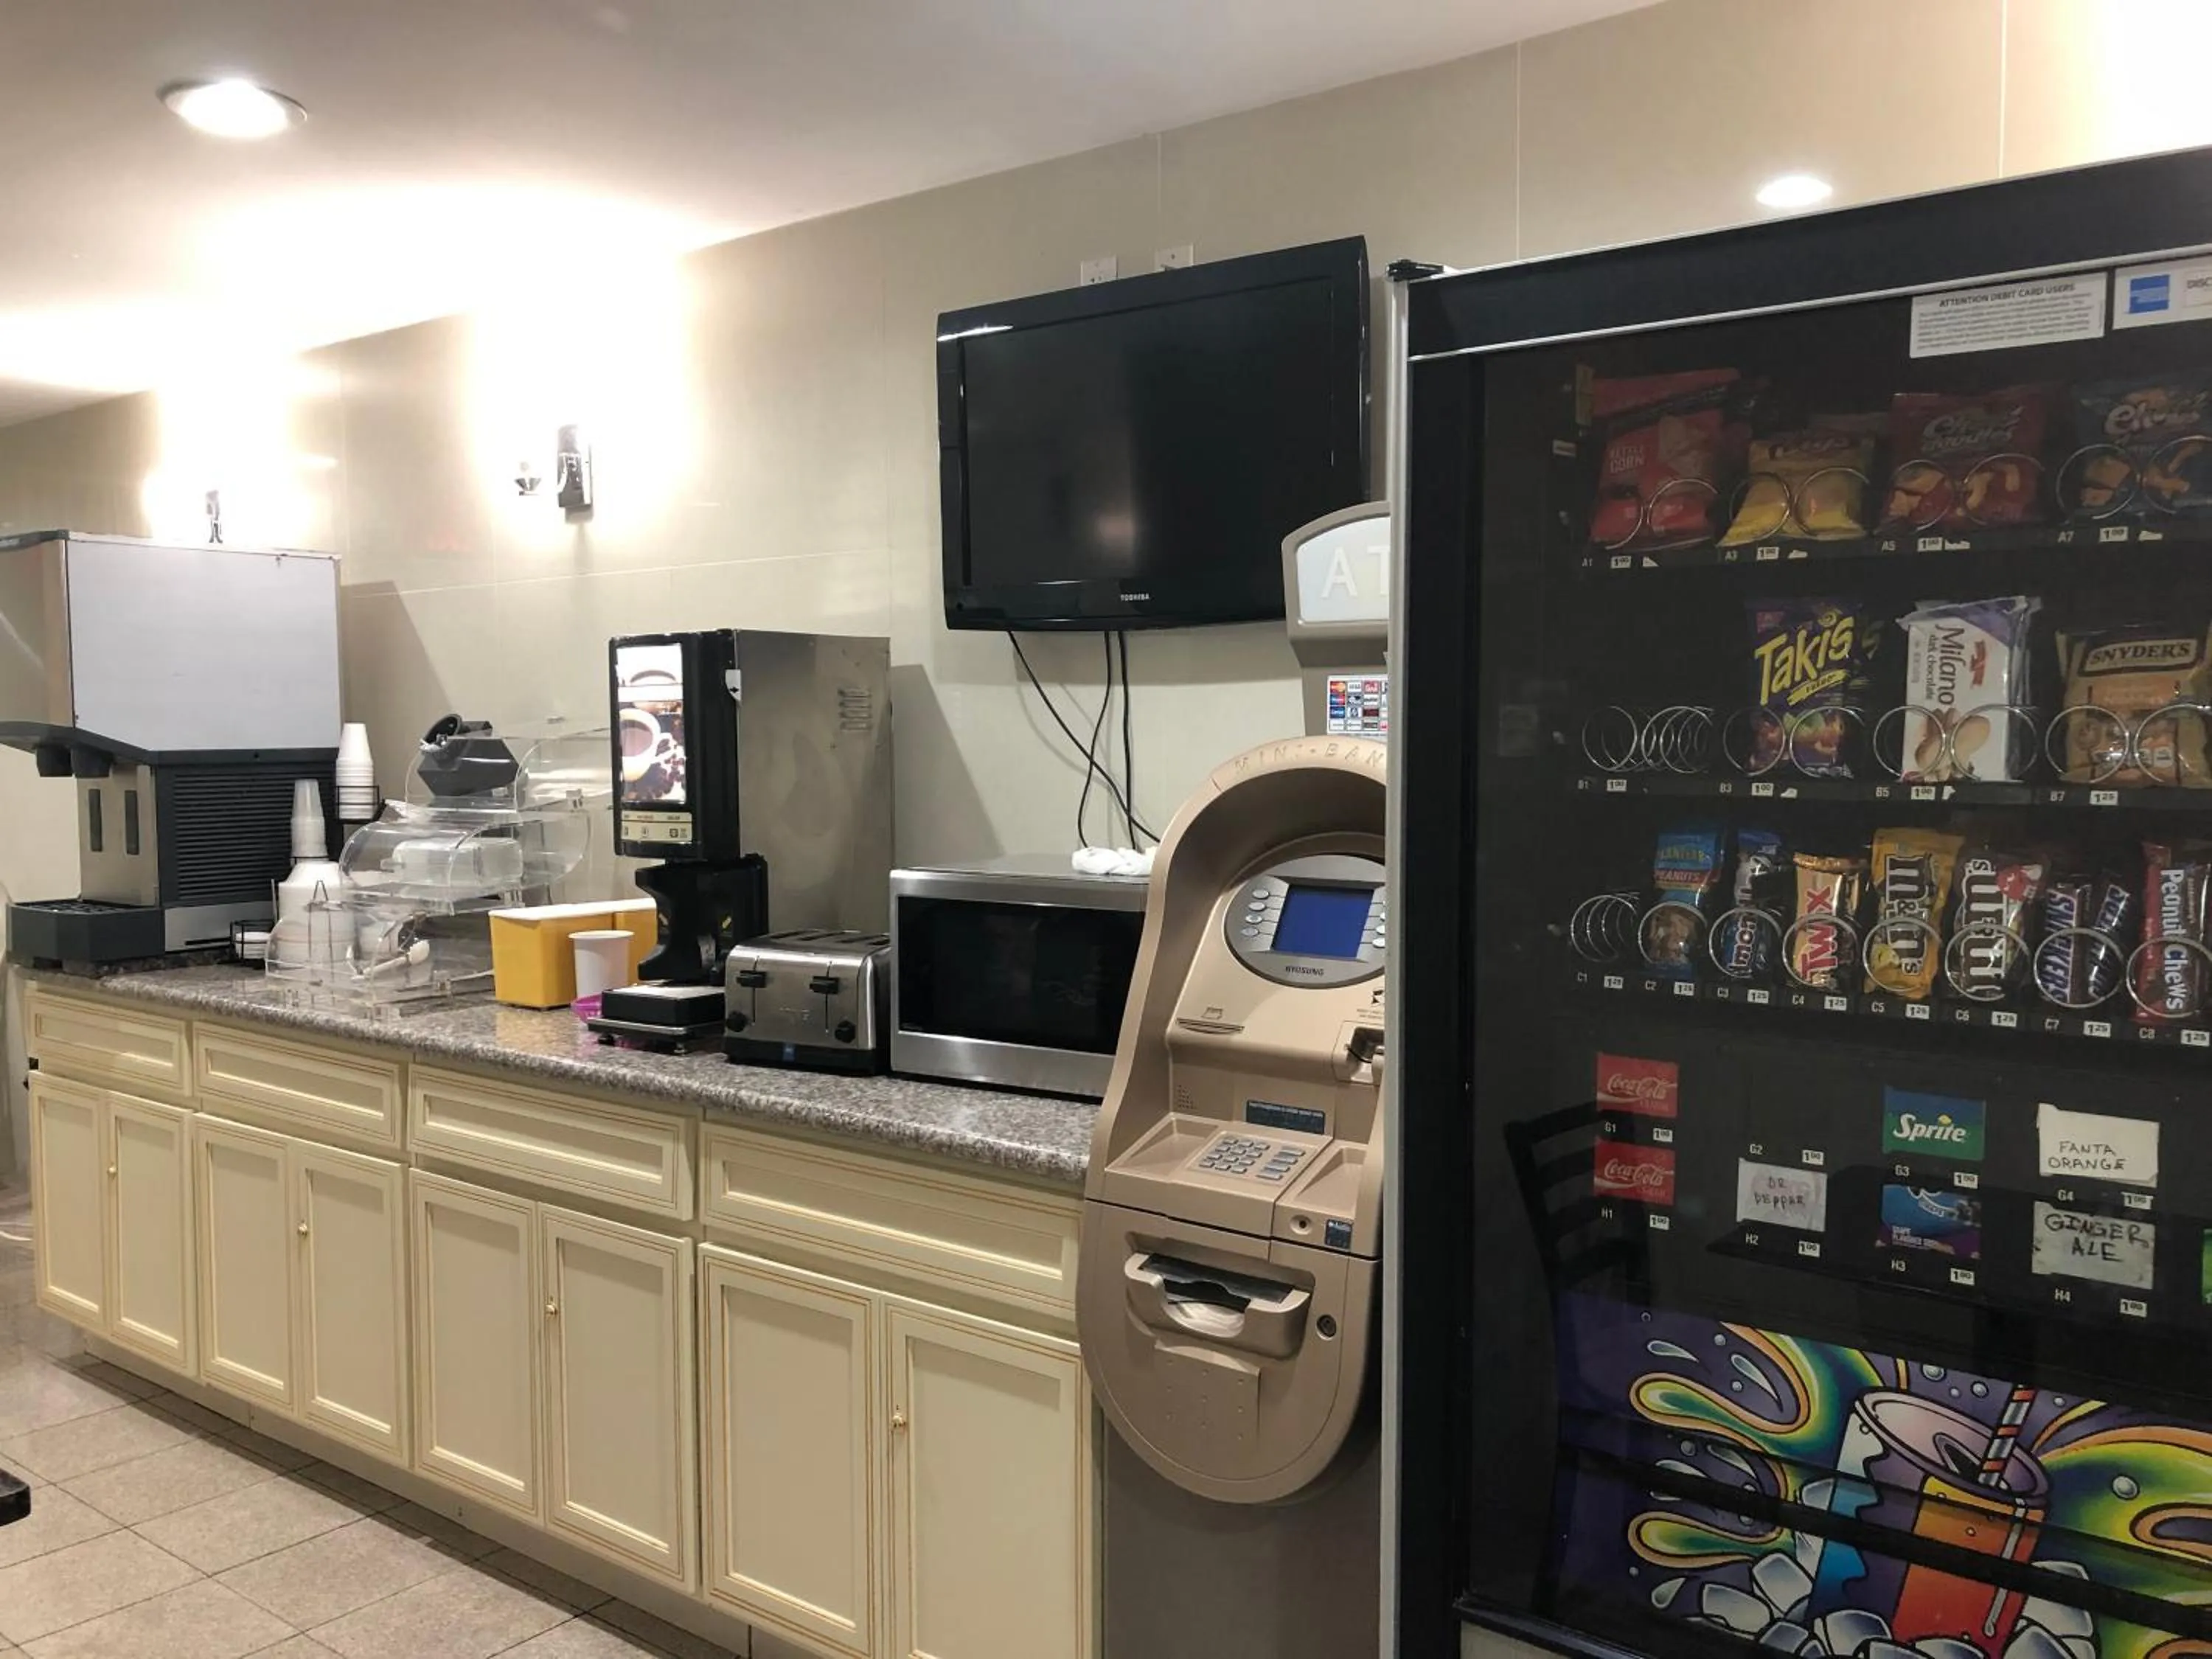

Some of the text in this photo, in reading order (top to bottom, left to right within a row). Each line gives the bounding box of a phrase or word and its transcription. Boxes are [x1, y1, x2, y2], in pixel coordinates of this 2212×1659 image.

[1939, 283, 2076, 307] ATTENTION DEBIT CARD USERS
[1119, 593, 1150, 602] TOSHIBA
[1753, 609, 1856, 707] Takis
[1935, 624, 1966, 705] Milano
[2160, 869, 2188, 937] Peanut
[1799, 886, 1837, 981] TWX
[2041, 890, 2076, 1003] SNCKERS
[1893, 1113, 1969, 1143] Sprite
[2059, 1140, 2117, 1158] FANTA
[2048, 1155, 2127, 1171] ORANGE
[1601, 1208, 1613, 1219] H1
[1745, 1233, 1759, 1245] H2
[2045, 1213, 2150, 1249] GINGER
[2071, 1237, 2124, 1263] ALE
[1891, 1259, 1907, 1273] H3
[2054, 1288, 2071, 1301] H4
